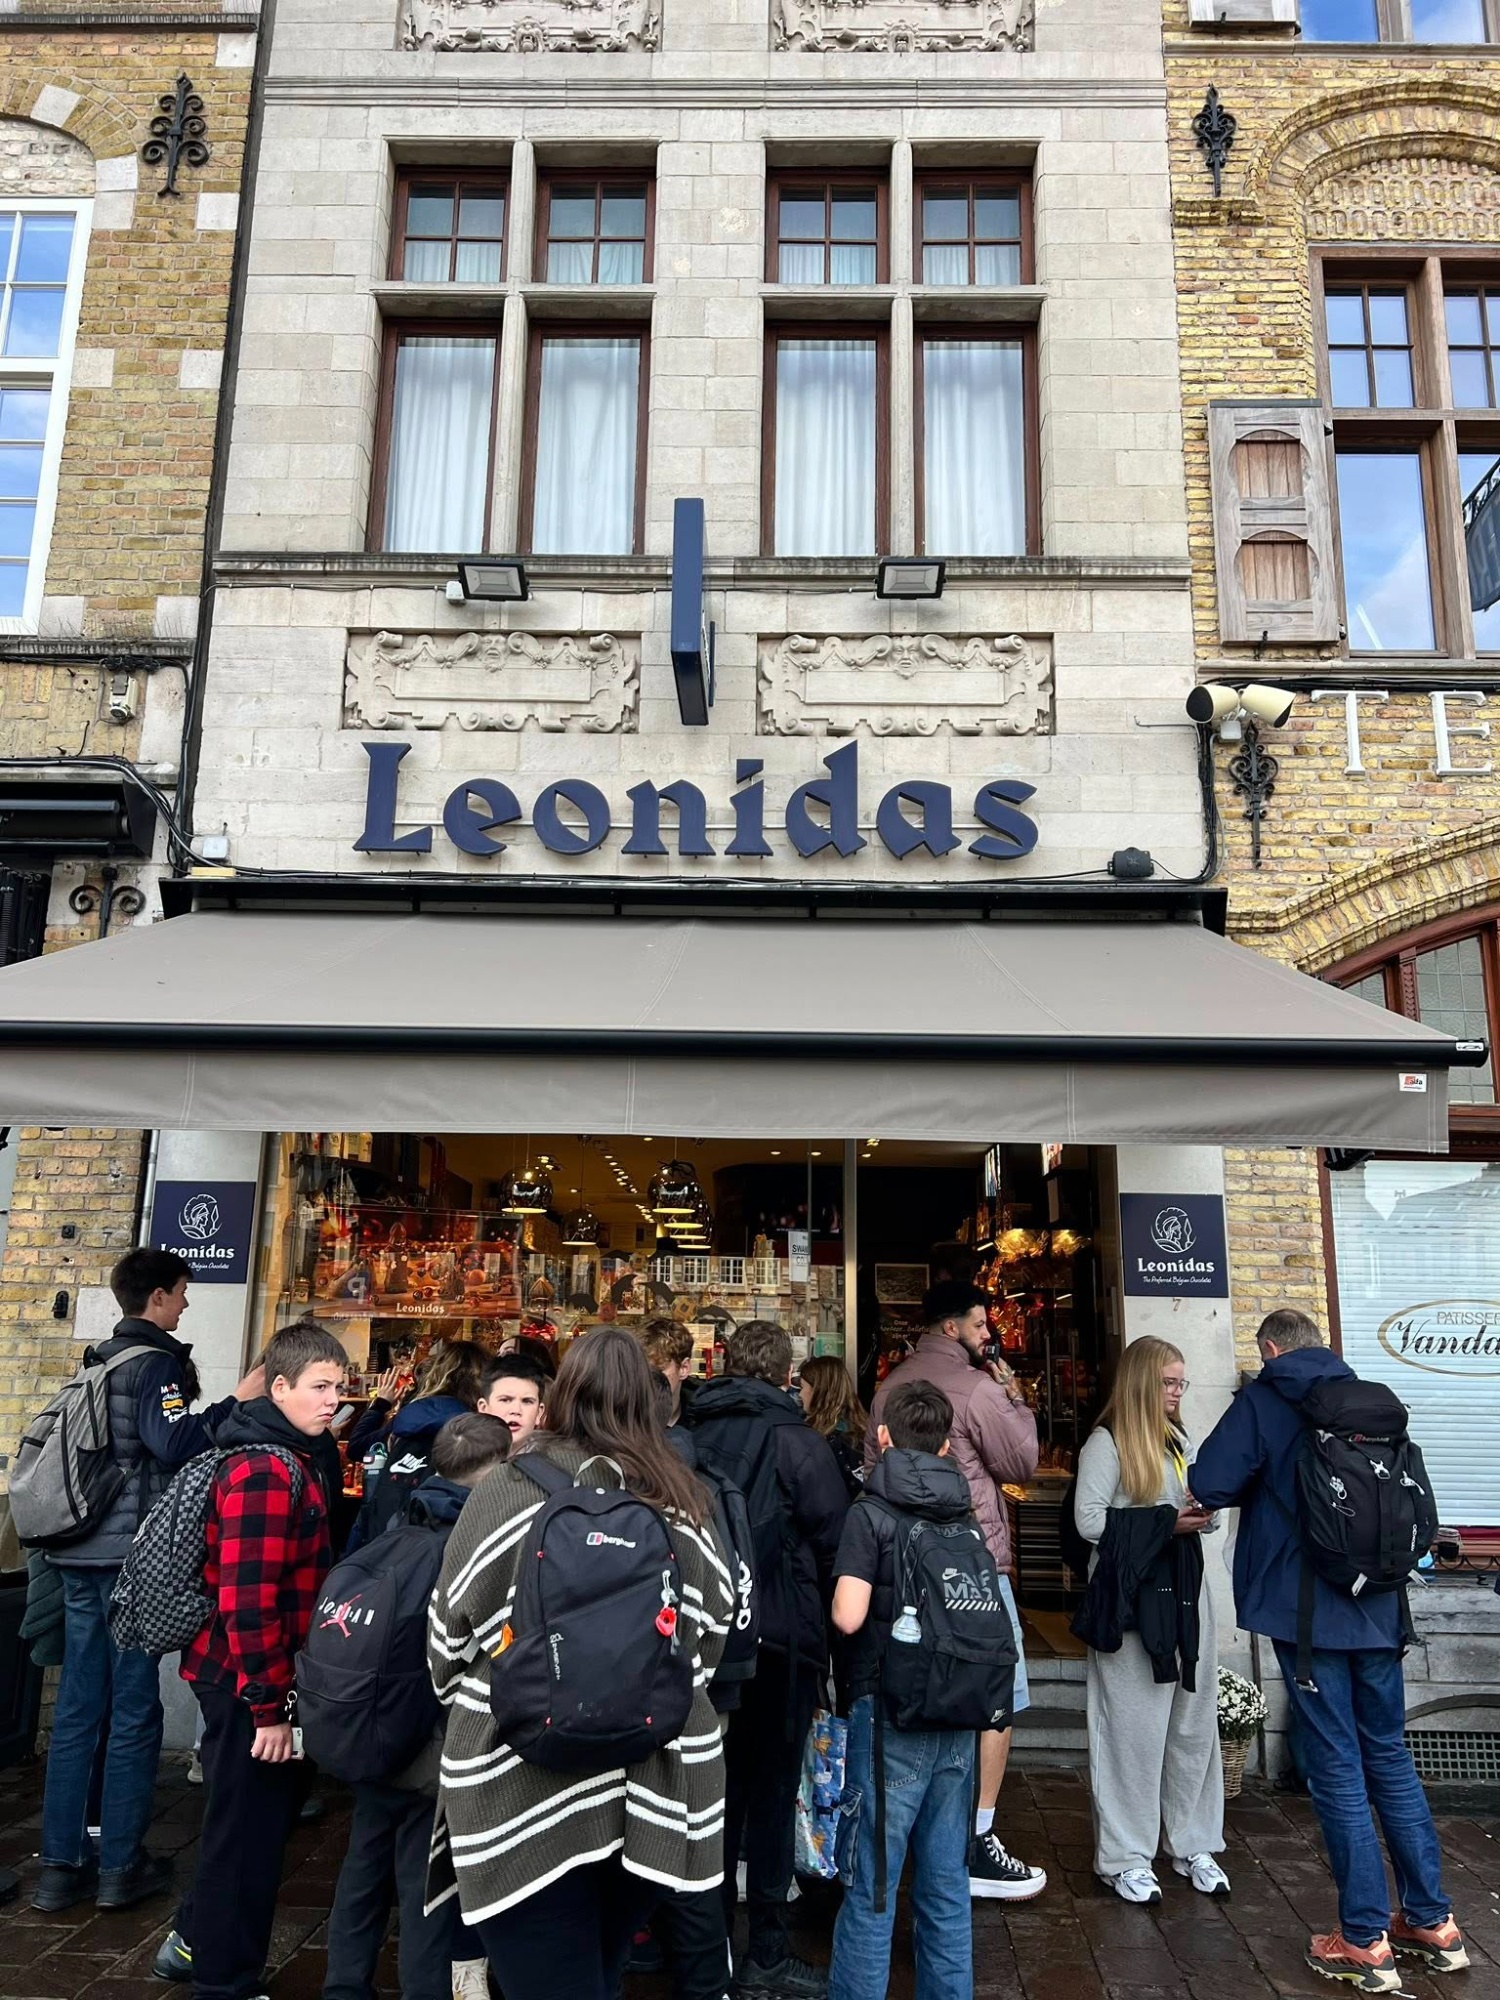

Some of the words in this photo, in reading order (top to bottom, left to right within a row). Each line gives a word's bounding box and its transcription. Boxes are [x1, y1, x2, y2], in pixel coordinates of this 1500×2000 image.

[352, 739, 1039, 860] Leonidas
[1137, 1257, 1215, 1273] Leonidas
[396, 1302, 445, 1313] Leonidas
[318, 1596, 375, 1626] JOAN
